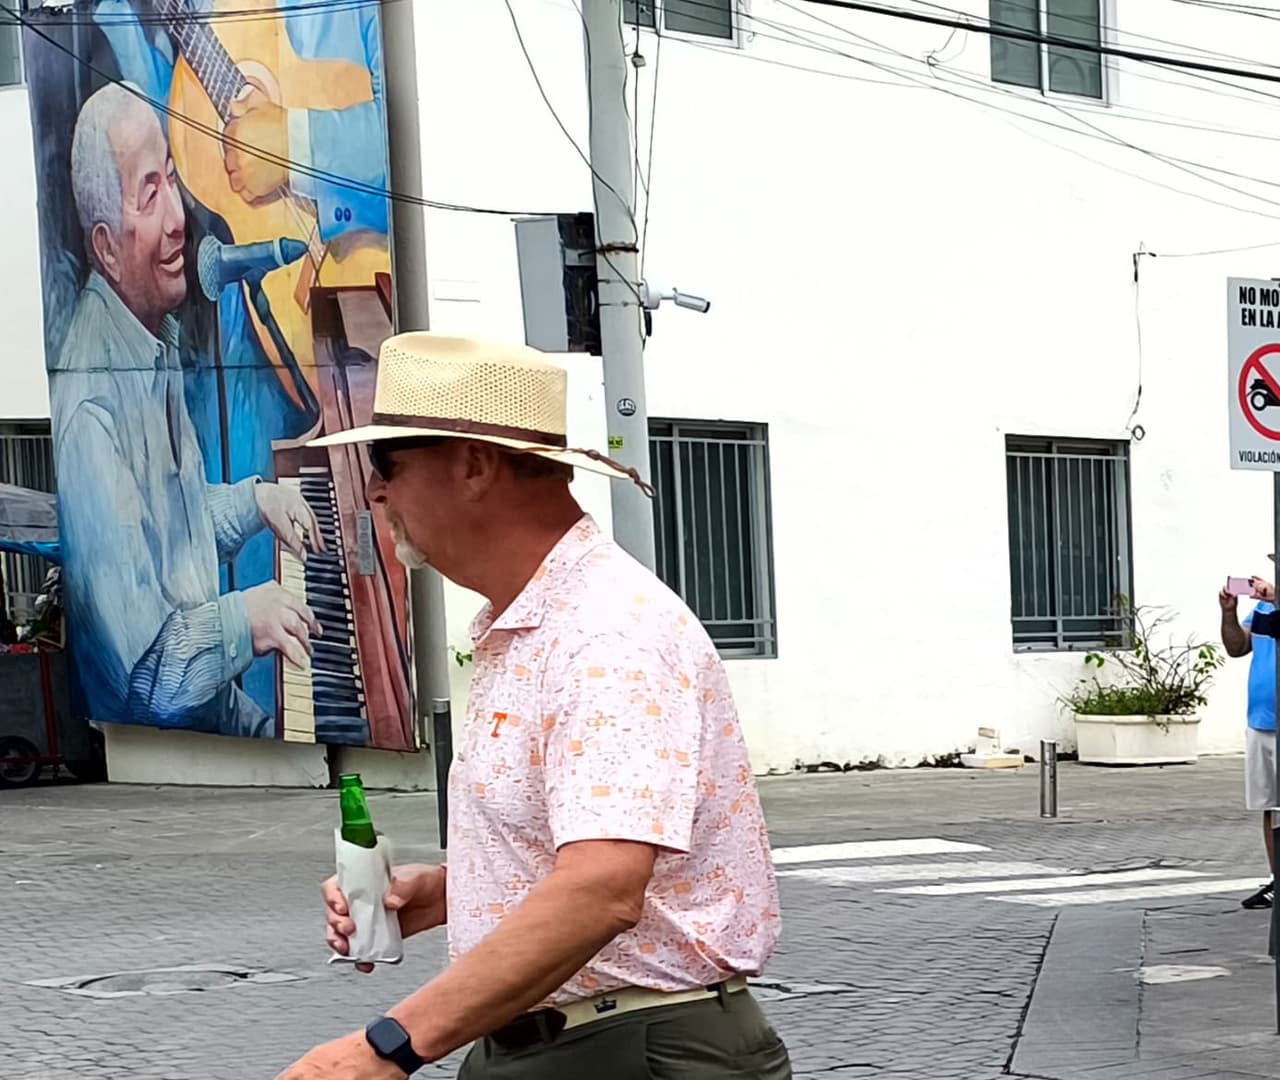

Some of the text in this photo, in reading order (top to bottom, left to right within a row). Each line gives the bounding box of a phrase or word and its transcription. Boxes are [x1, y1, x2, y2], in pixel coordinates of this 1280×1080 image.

[1239, 286, 1256, 305] NO
[1241, 308, 1256, 326] EN
[1260, 309, 1274, 328] LA
